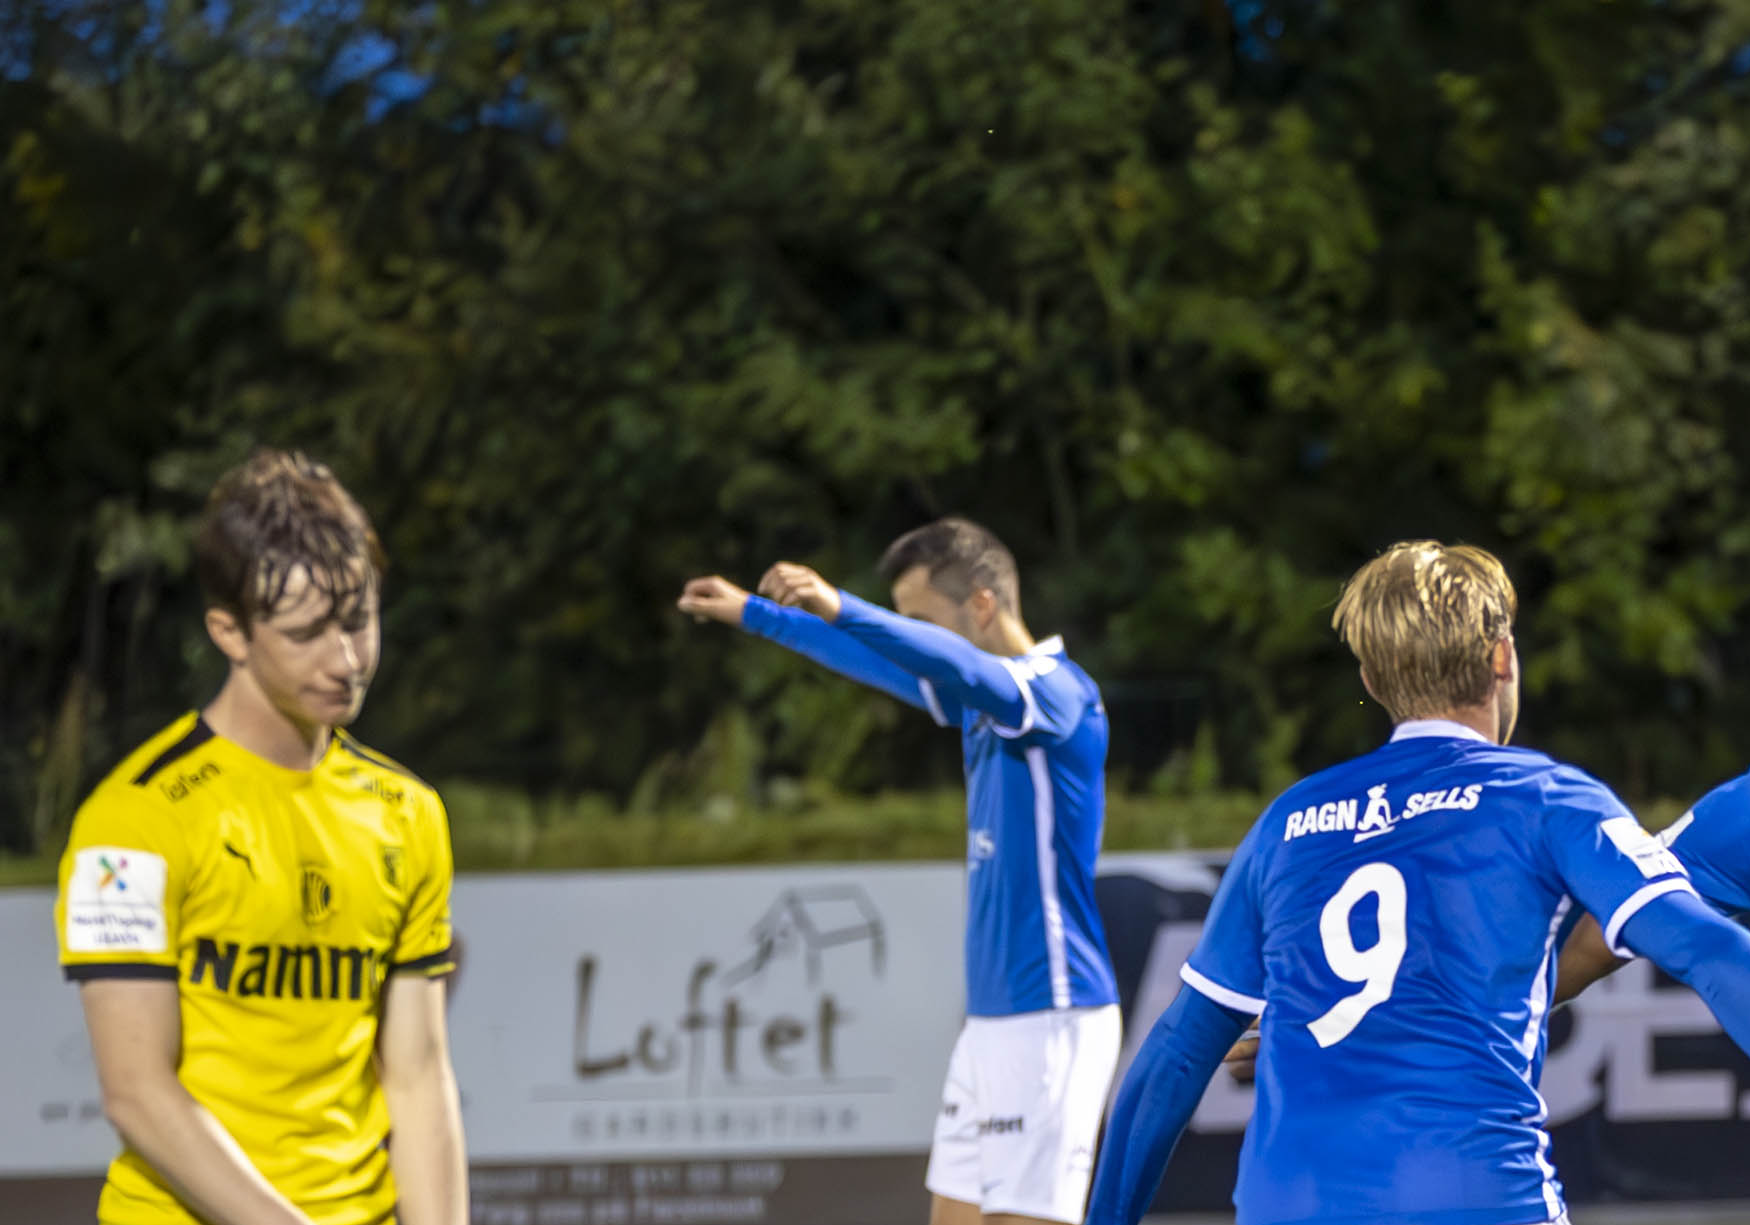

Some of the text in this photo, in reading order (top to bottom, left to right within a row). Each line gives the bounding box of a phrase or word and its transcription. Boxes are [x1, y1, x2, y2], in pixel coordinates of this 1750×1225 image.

[1284, 784, 1483, 842] RAGN SELLS
[573, 951, 858, 1098] Loftet
[1306, 862, 1408, 1048] 9
